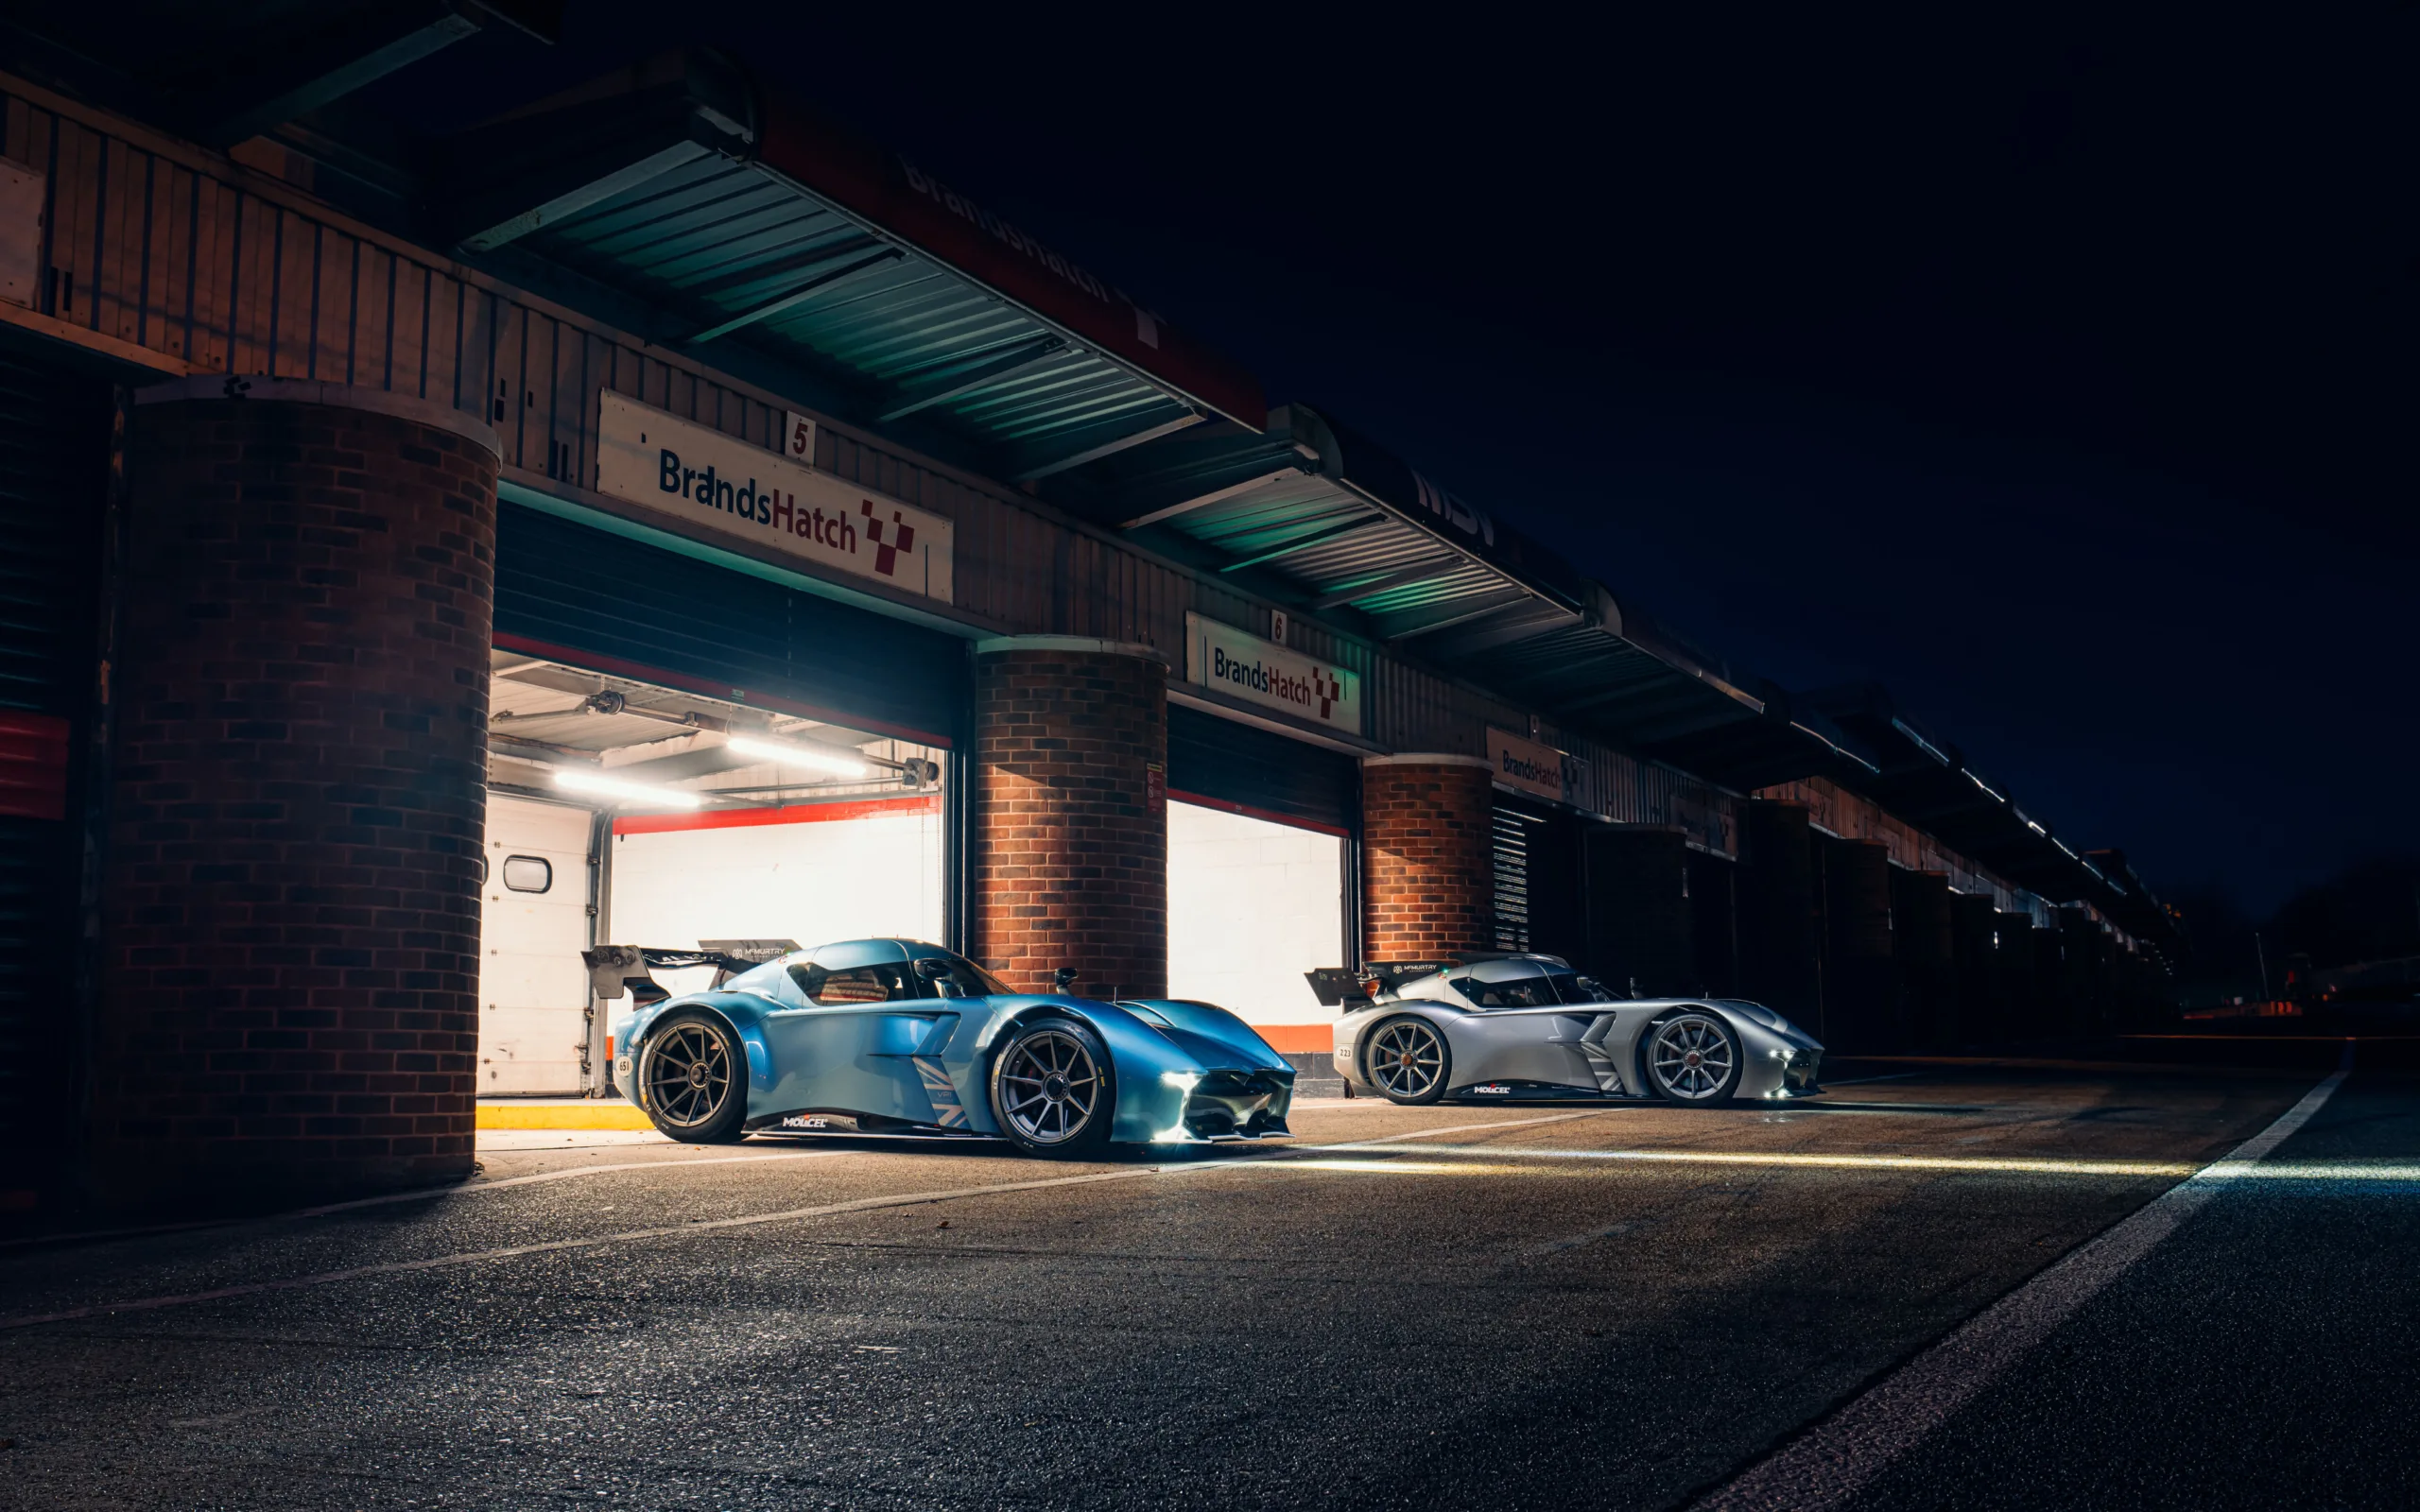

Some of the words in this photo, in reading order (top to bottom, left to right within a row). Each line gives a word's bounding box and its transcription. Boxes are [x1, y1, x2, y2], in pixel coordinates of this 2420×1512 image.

[792, 422, 808, 455] 5
[659, 448, 856, 555] BrandsHatch
[1274, 616, 1282, 640] 6
[1215, 647, 1311, 707] BrandsHatch
[619, 1060, 630, 1072] 651
[1340, 1048, 1351, 1057] 223
